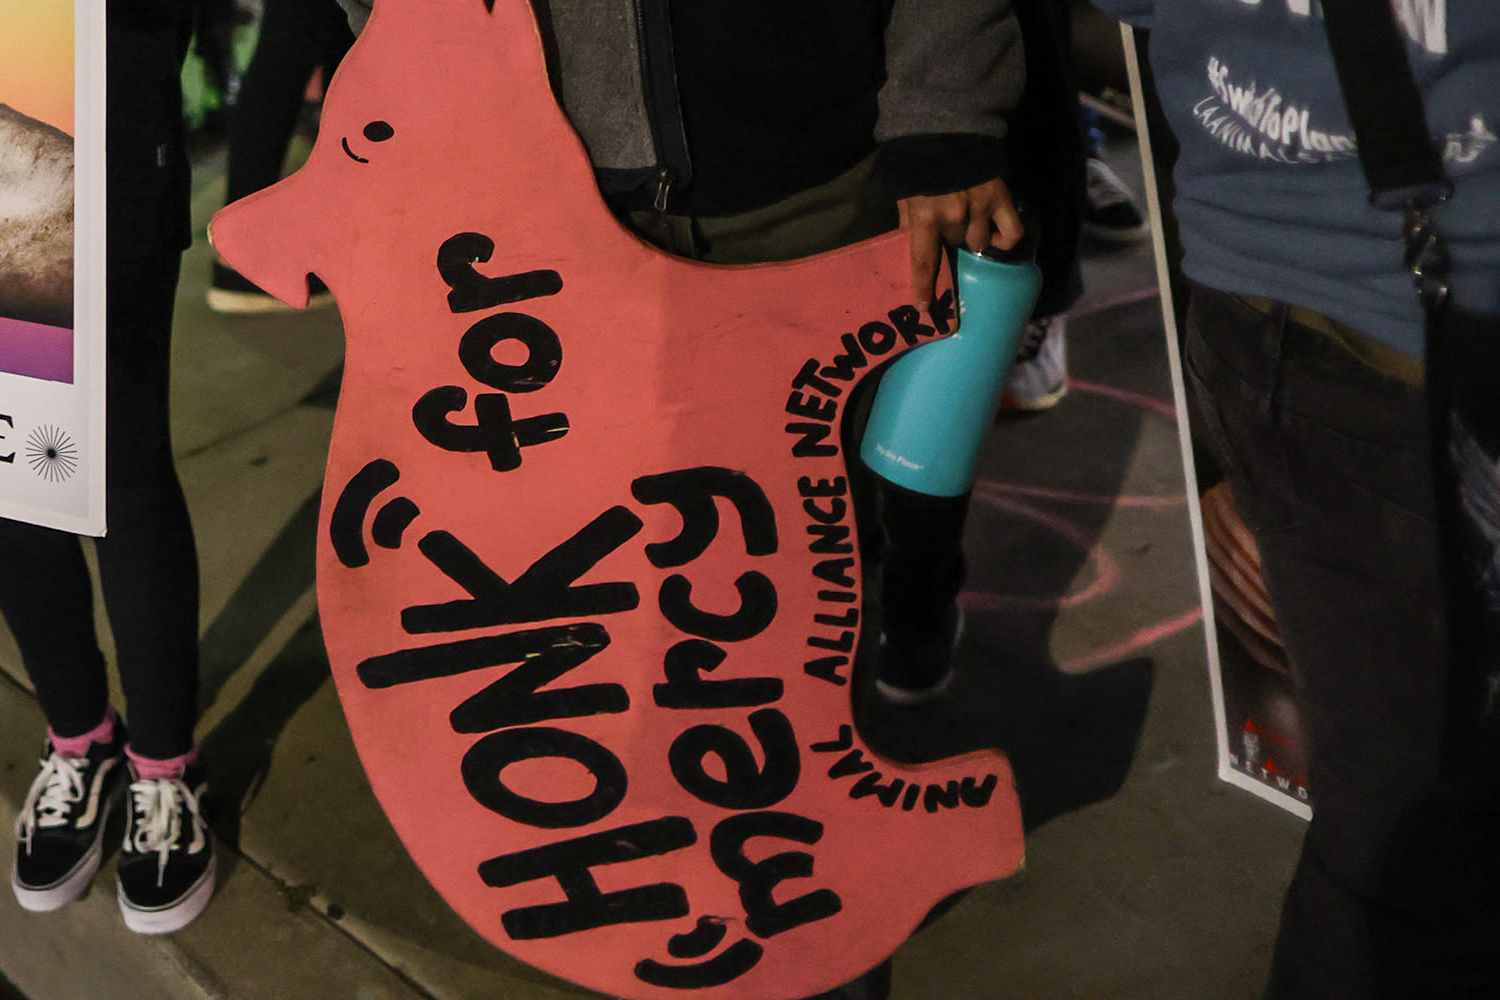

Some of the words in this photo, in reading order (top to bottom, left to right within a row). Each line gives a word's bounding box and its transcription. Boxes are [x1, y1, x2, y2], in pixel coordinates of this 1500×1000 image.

[412, 231, 570, 473] for
[784, 288, 957, 458] NETWORK
[797, 476, 859, 687] ALLIANCE
[357, 505, 697, 941] HONK
[632, 465, 844, 940] mercy
[809, 724, 998, 813] ANIMAL
